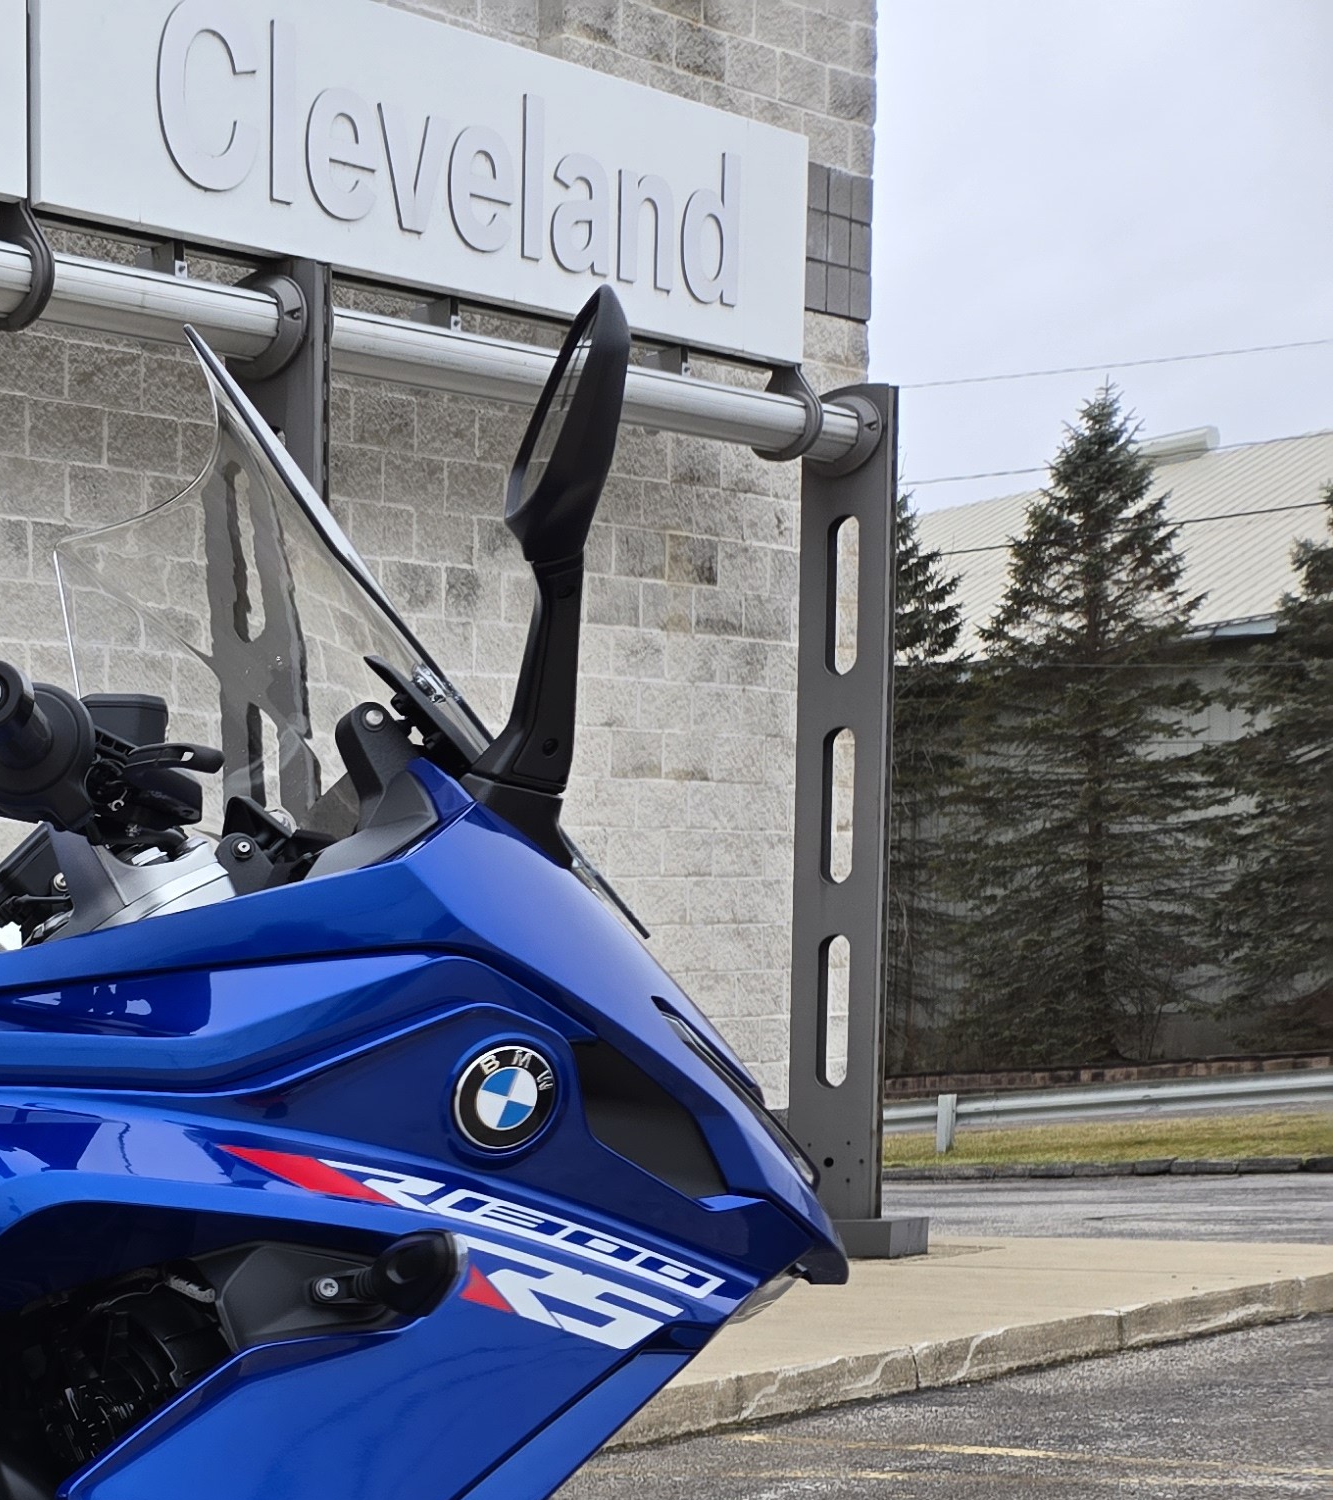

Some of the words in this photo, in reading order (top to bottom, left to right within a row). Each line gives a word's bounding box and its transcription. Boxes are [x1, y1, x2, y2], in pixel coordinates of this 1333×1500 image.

[155, 0, 743, 307] Cleveland
[480, 1048, 558, 1092] BMW
[455, 1233, 684, 1350] RS
